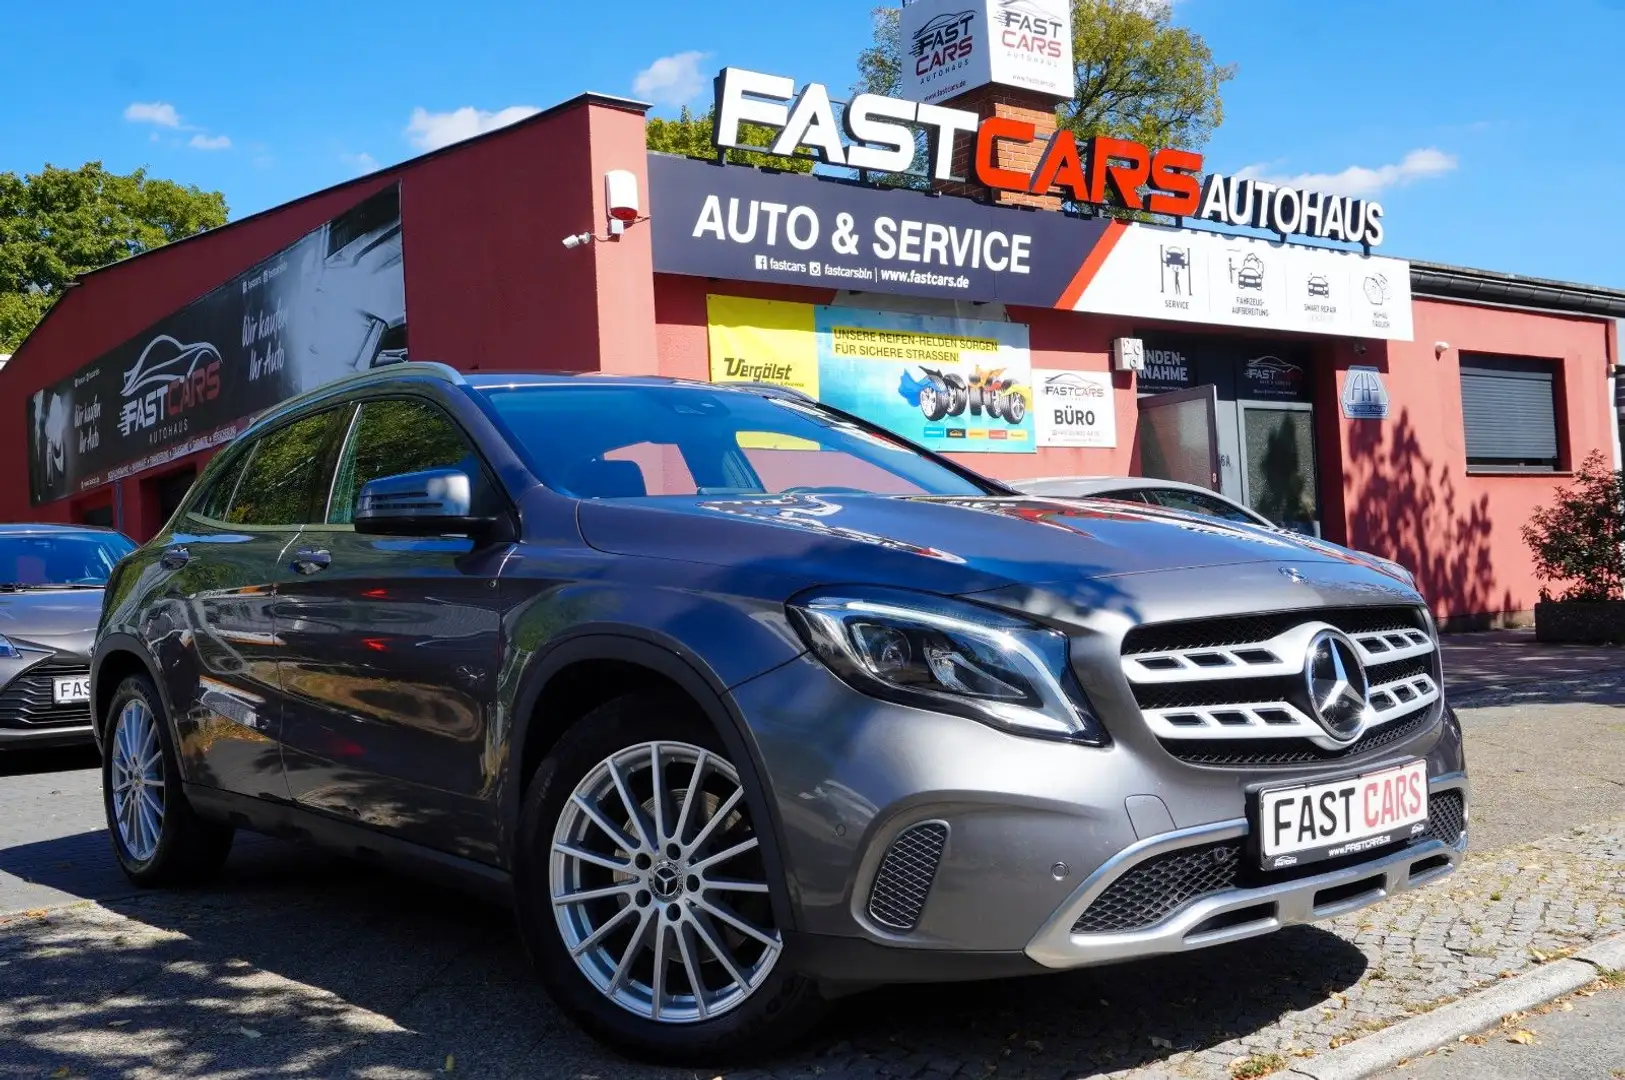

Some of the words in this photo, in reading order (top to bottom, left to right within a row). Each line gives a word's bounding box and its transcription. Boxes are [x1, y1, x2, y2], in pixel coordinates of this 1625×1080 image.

[912, 15, 974, 56] FAST
[1004, 10, 1063, 38] FAST
[916, 35, 973, 76] CARS
[1002, 30, 1062, 58] CARS
[920, 59, 969, 85] AUTOHAUS
[1201, 173, 1384, 247] AUTOHAUS
[692, 194, 820, 251] AUTO
[831, 212, 859, 256] &
[872, 216, 1032, 274] SERVICE
[769, 258, 807, 273] fastcars
[824, 264, 873, 280] fastcarsbln
[881, 269, 970, 289] www.fastcars.de
[1164, 300, 1189, 310] SERVICE
[833, 328, 876, 342] UNSERE
[879, 332, 957, 349] REIFEN-HELDEN
[959, 338, 998, 351] SORGEN
[835, 343, 857, 355] FÜR
[859, 345, 903, 358] SICHERE
[906, 348, 959, 362] STRASSEN!
[263, 340, 285, 375] Auto
[724, 357, 793, 383] Vergölst
[1136, 365, 1188, 381] NNAHME
[1054, 405, 1095, 426] BÜRO
[149, 418, 189, 444] AUTOHAUS
[60, 681, 90, 698] FAS
[1274, 787, 1356, 847] FAST
[1363, 771, 1421, 828] CARS
